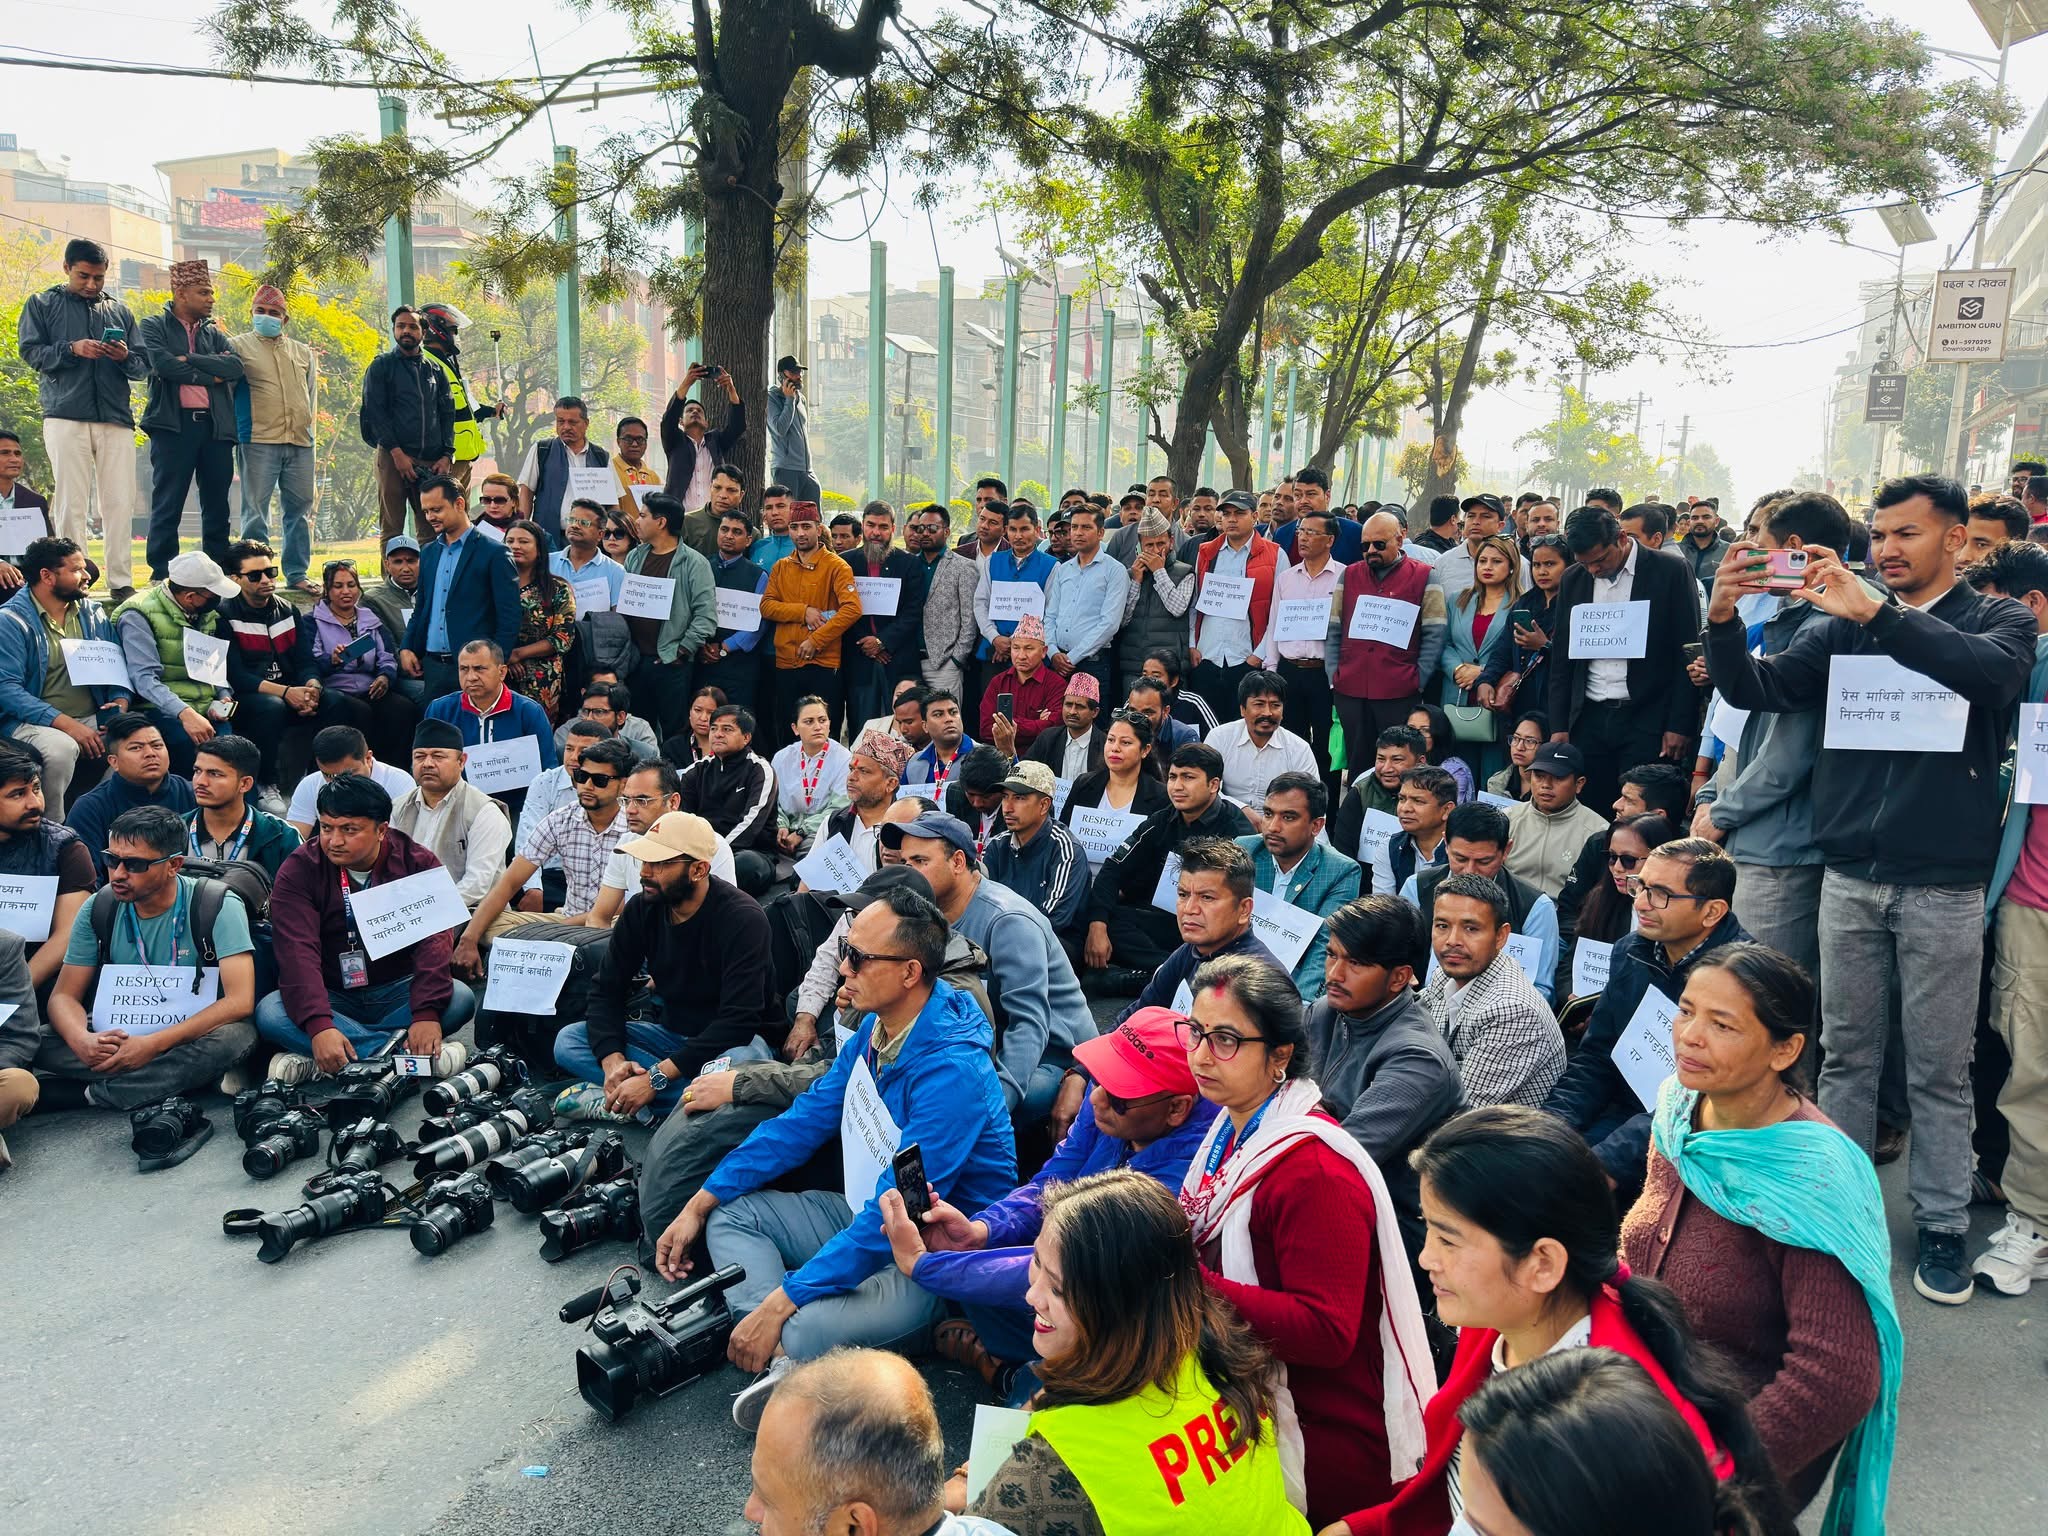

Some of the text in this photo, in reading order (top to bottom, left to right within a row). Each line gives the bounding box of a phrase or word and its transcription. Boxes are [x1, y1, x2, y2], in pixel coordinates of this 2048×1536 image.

[1582, 610, 1624, 620] RESPECT
[1580, 624, 1610, 633] PRESS
[1580, 637, 1627, 647] FREEDOM
[1841, 688, 1957, 702] प्रेस माथिको आक्रमण
[1840, 706, 1901, 722] निन्दनीय छ
[1081, 814, 1124, 827] RESPECT
[1078, 827, 1107, 838] PRESS
[1080, 840, 1118, 852] REEDO
[366, 894, 436, 928] पत्रकार सुरक्षाको
[410, 916, 423, 926] गर
[115, 976, 183, 988] RESPECT
[112, 994, 159, 1006] PRESS
[110, 1013, 186, 1025] FREEDOM
[1119, 1024, 1148, 1054] adidas
[1630, 1048, 1642, 1064] गर
[855, 1080, 871, 1112] Killing
[856, 1115, 867, 1132] not
[864, 1128, 880, 1158] Killed
[1208, 1144, 1222, 1169] PRESS
[1147, 1396, 1258, 1508] PRE
